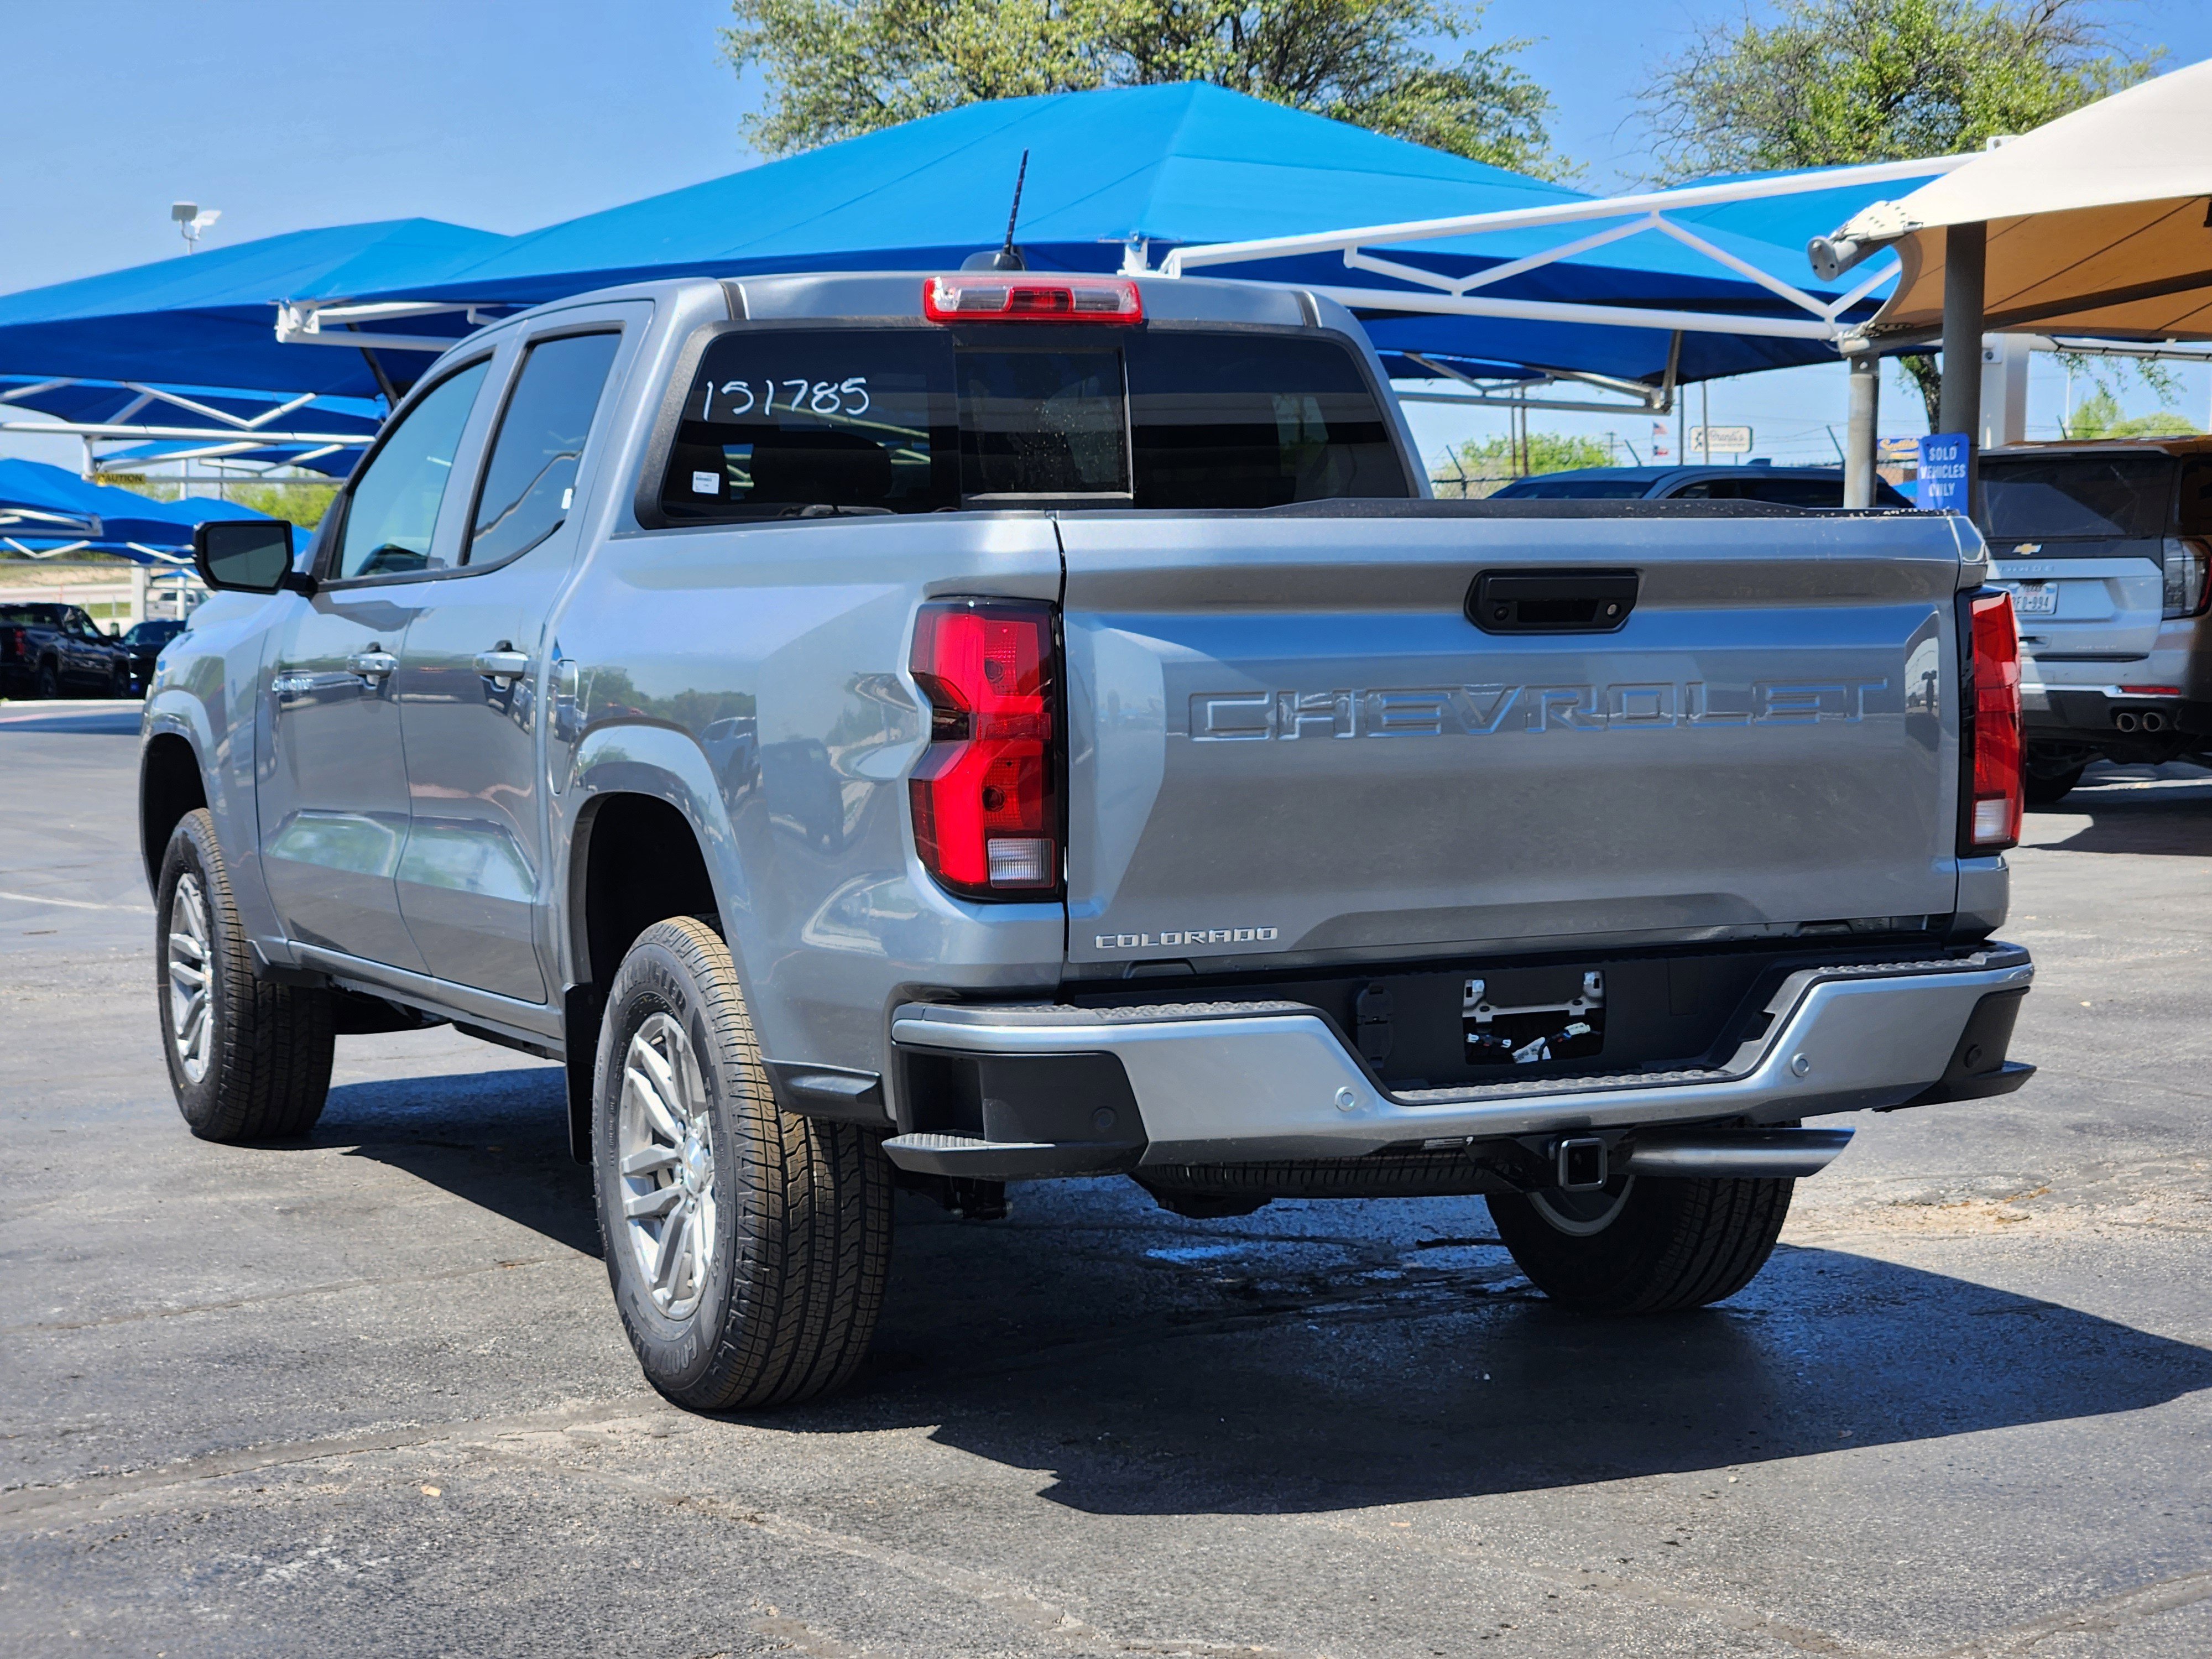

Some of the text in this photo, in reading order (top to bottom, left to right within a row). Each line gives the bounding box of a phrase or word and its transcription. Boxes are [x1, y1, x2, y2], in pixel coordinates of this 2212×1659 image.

[703, 377, 870, 421] 151785
[1929, 446, 1958, 461] SOLD
[1920, 463, 1966, 479] VEHICLES
[1928, 482, 1955, 497] ONLY
[1188, 676, 1888, 741] CHEVROLET
[1095, 926, 1278, 949] COLORADO
